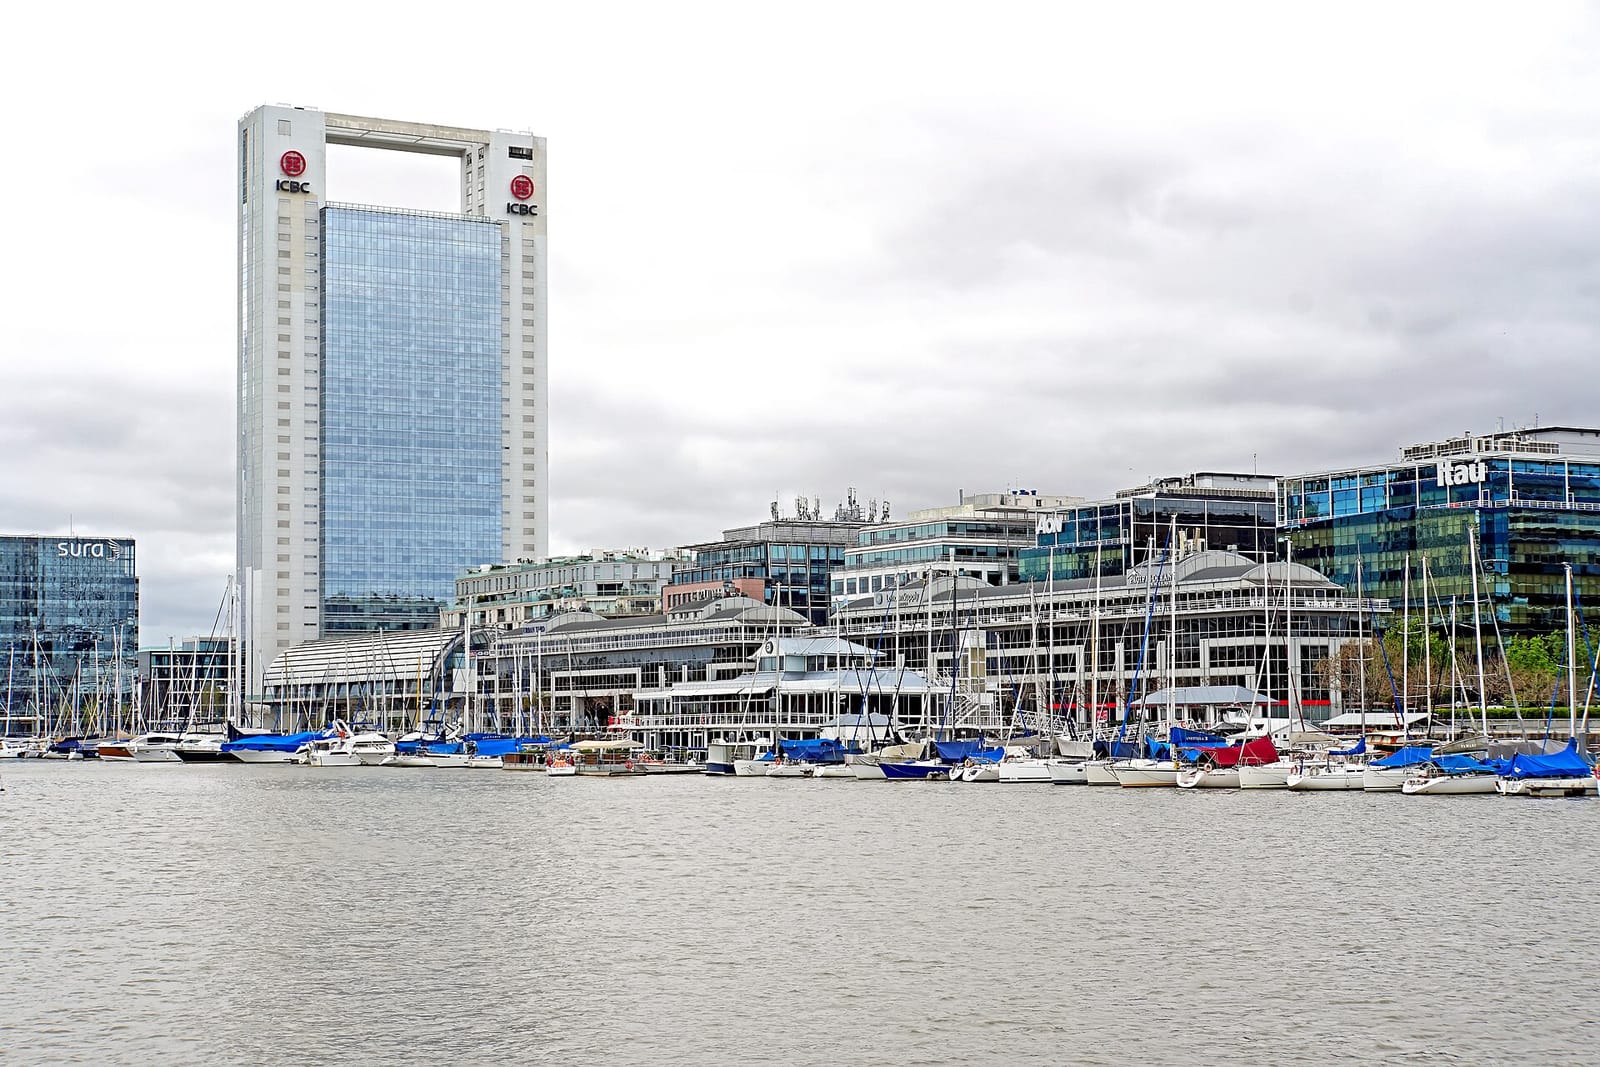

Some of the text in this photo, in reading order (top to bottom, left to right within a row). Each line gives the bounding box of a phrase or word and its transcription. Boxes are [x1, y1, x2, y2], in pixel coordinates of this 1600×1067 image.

[276, 179, 310, 193] ICBC
[507, 202, 538, 216] ICBC
[1036, 514, 1063, 535] AON
[57, 542, 104, 557] sura
